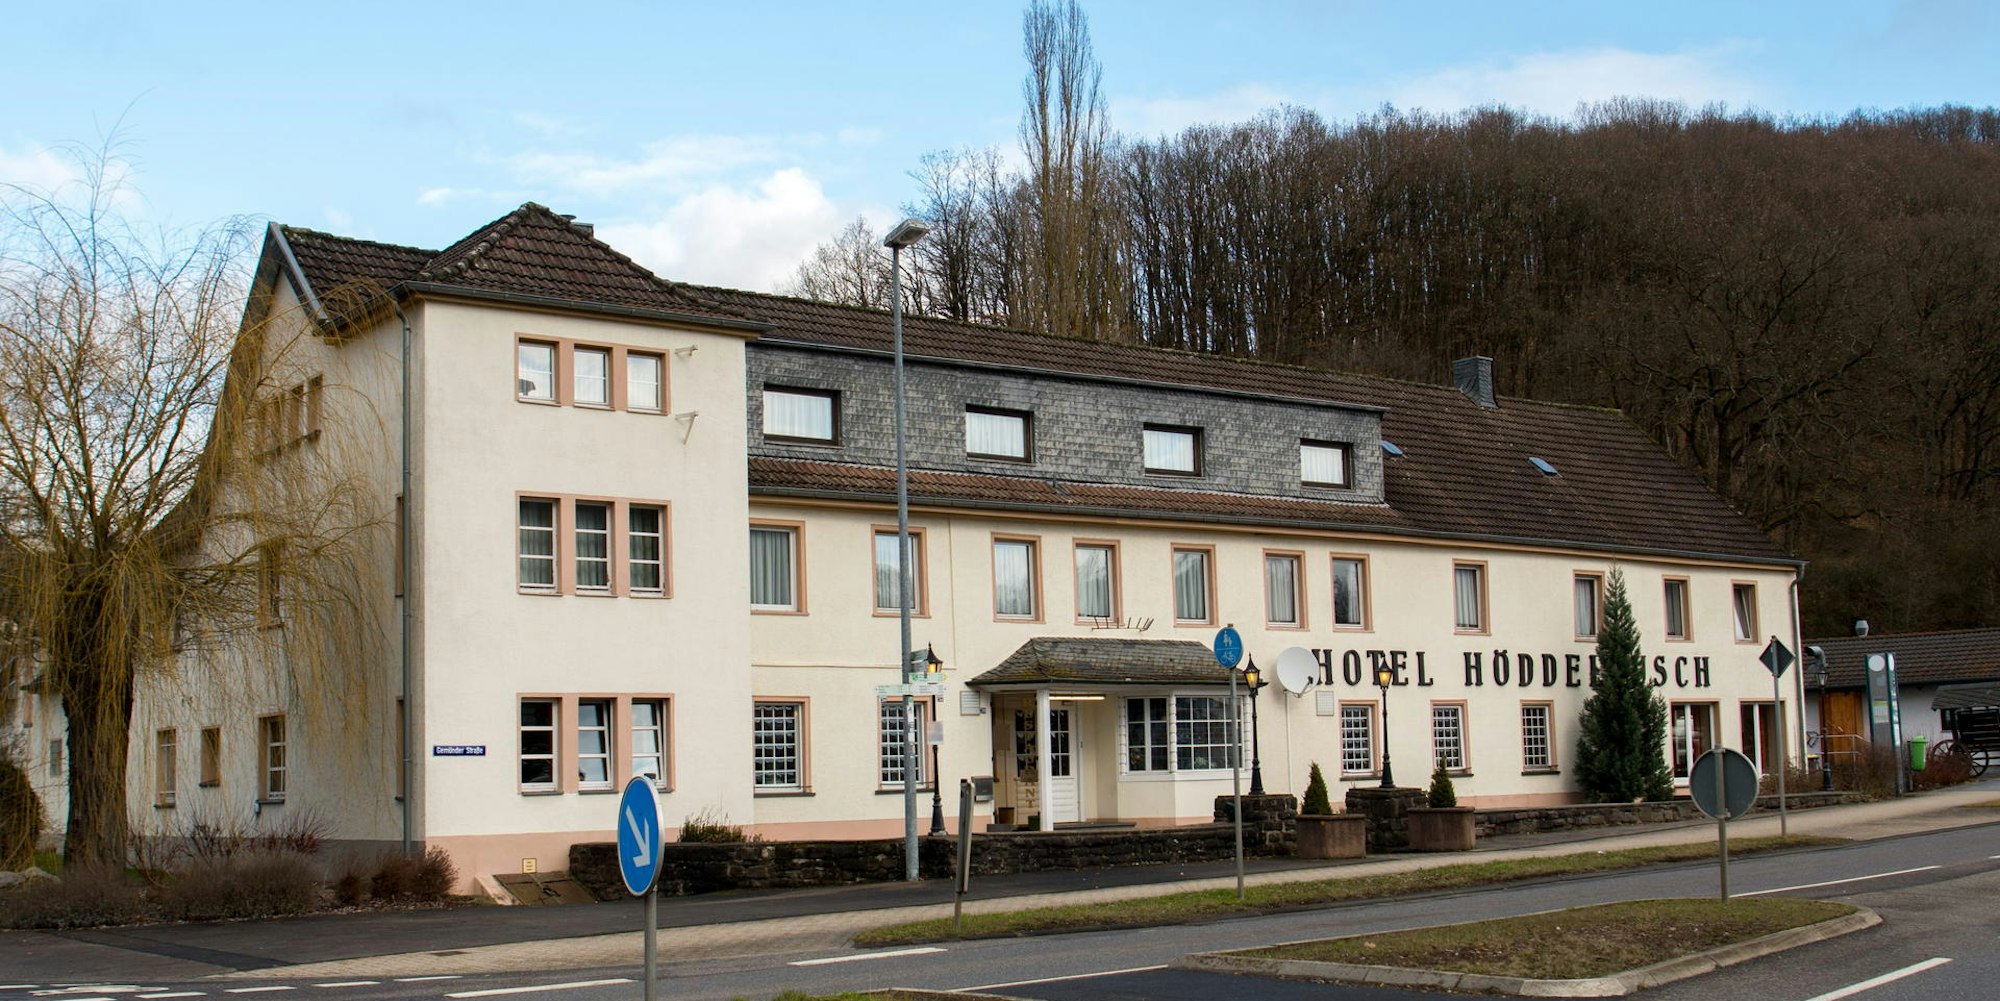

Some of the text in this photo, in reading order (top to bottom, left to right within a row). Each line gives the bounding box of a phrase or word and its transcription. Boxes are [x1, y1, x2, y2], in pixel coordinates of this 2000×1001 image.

[1312, 648, 1711, 688] HOTEL HÖDDESCH
[466, 746, 483, 755] Straße
